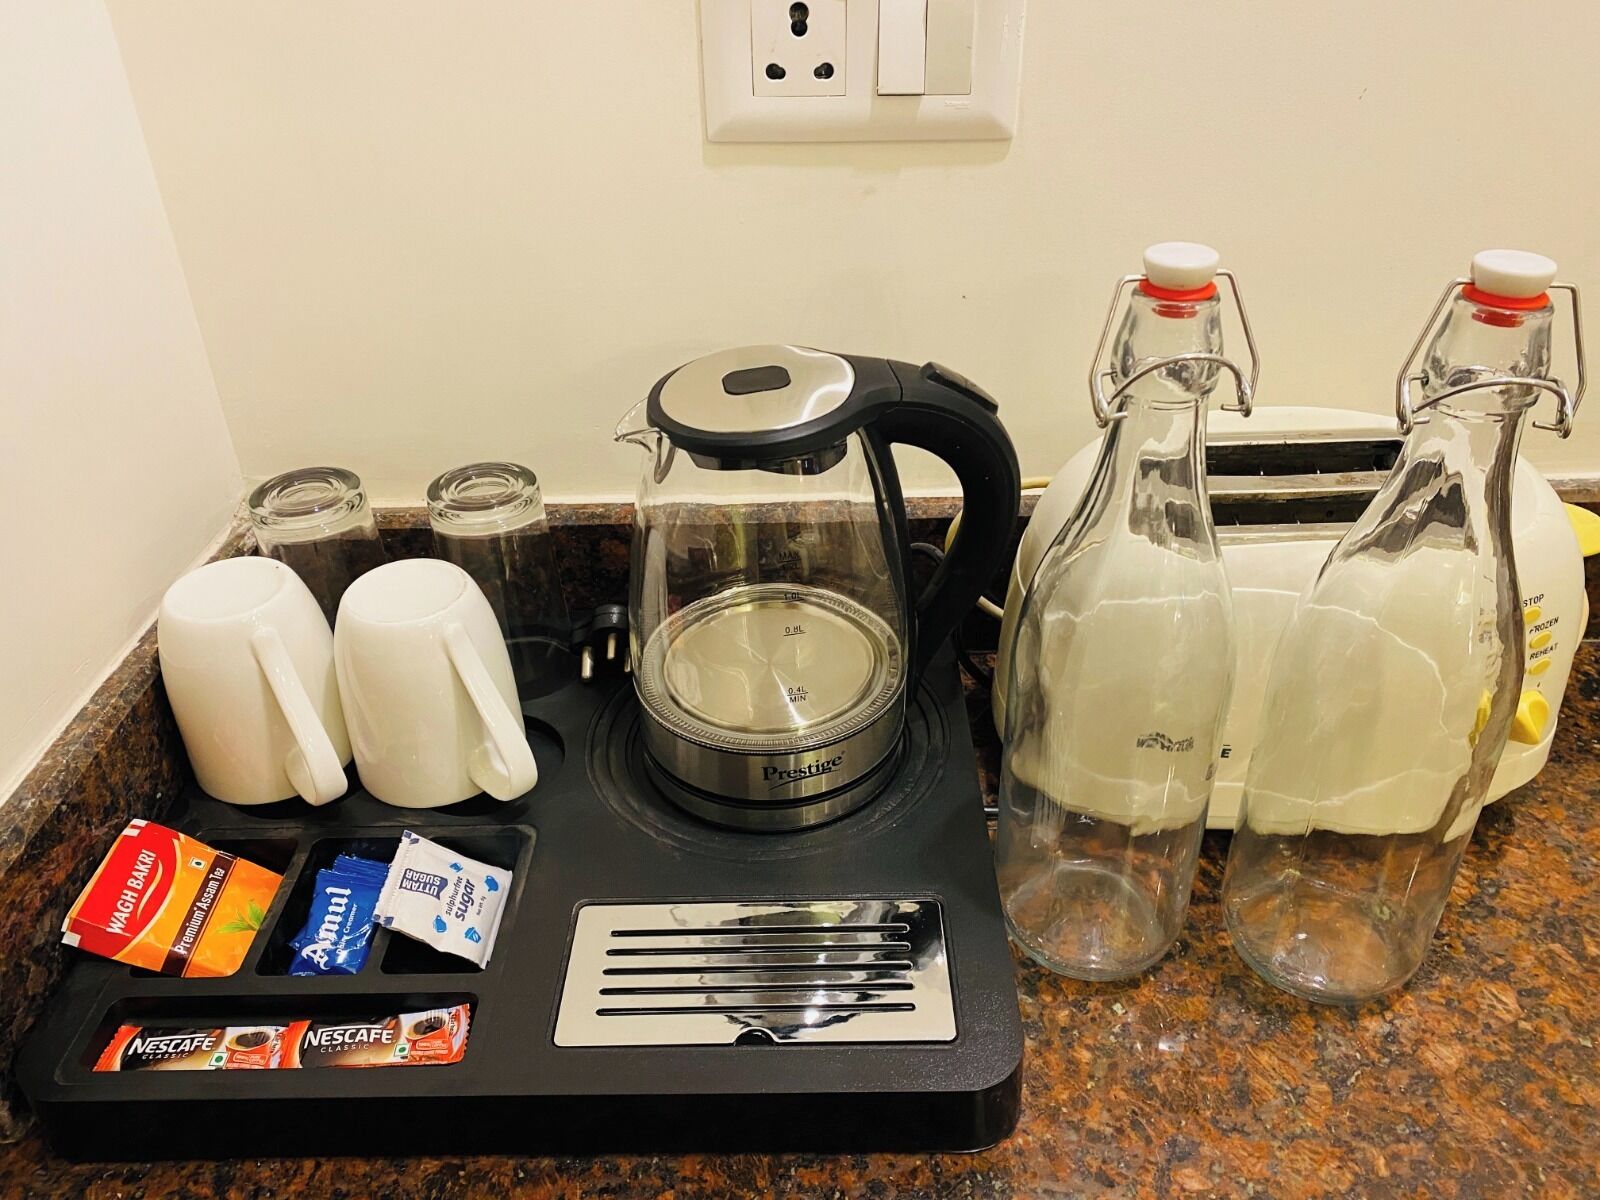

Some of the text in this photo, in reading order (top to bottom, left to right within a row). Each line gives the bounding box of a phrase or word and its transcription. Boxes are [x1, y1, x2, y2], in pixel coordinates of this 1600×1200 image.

[1523, 593, 1545, 608] STOP
[785, 625, 804, 634] 0.8L
[1529, 643, 1559, 660] REHEAT
[787, 687, 807, 695] 0.4L
[789, 695, 807, 703] MIN
[761, 755, 843, 781] Prestige
[405, 869, 442, 886] SUGAR
[106, 849, 157, 936] WAGH BAKRI
[401, 878, 439, 896] UTTAM
[455, 879, 476, 922] sugar
[174, 867, 225, 955] Premium Assam Tea
[301, 886, 351, 970] Amul
[320, 1044, 370, 1053] CLASSIC
